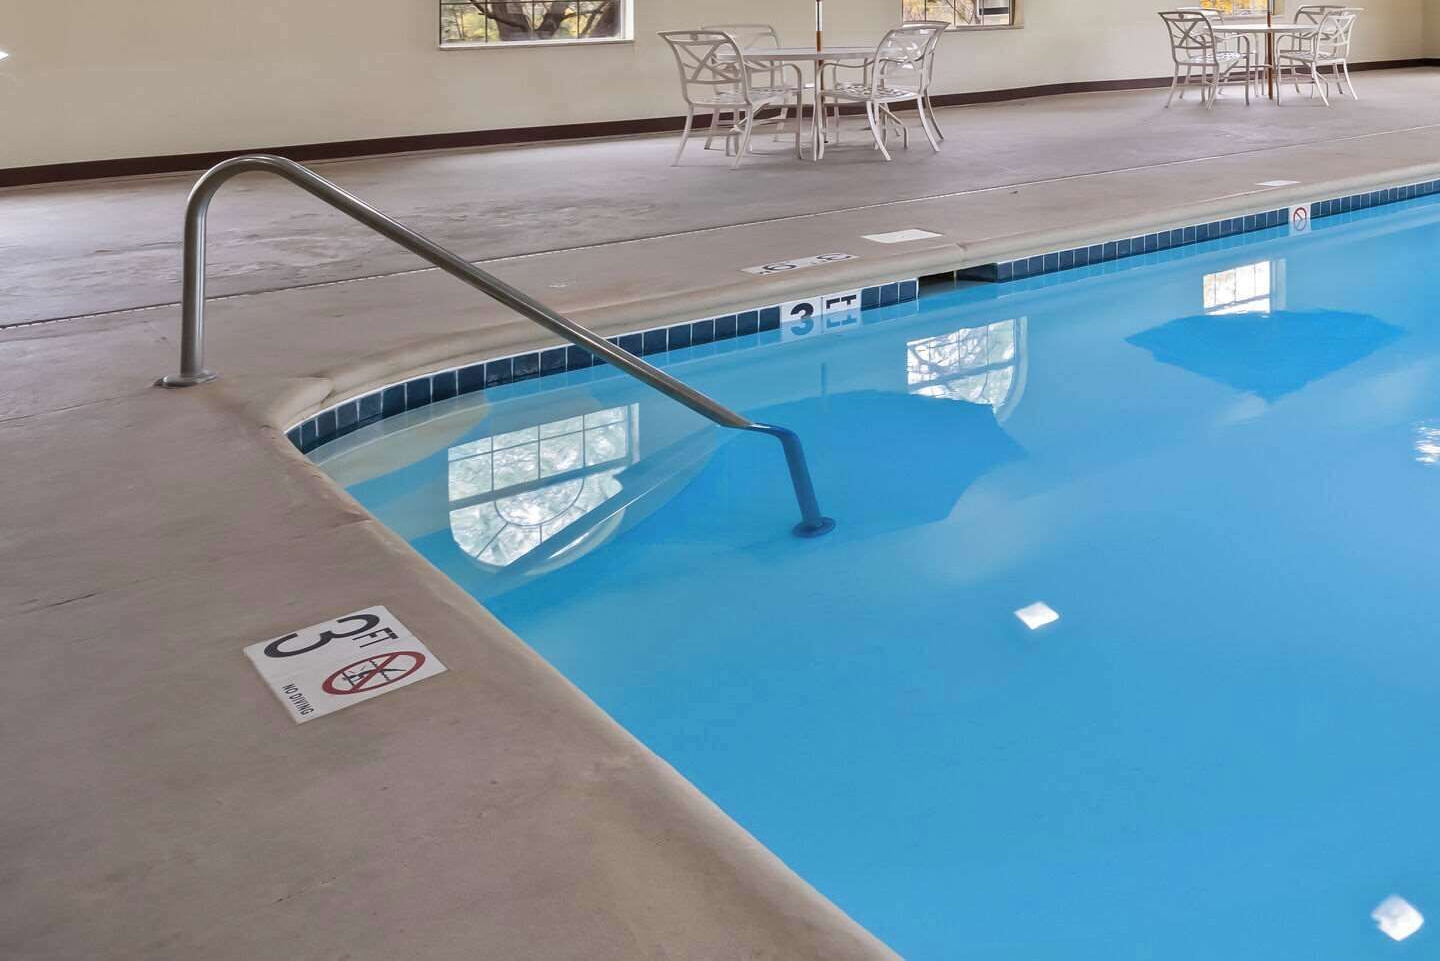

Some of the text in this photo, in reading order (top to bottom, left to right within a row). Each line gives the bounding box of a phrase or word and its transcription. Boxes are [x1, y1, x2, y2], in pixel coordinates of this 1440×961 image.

[790, 302, 814, 329] 3
[263, 613, 400, 658] 3 FT
[281, 683, 314, 715] NO DIVING
